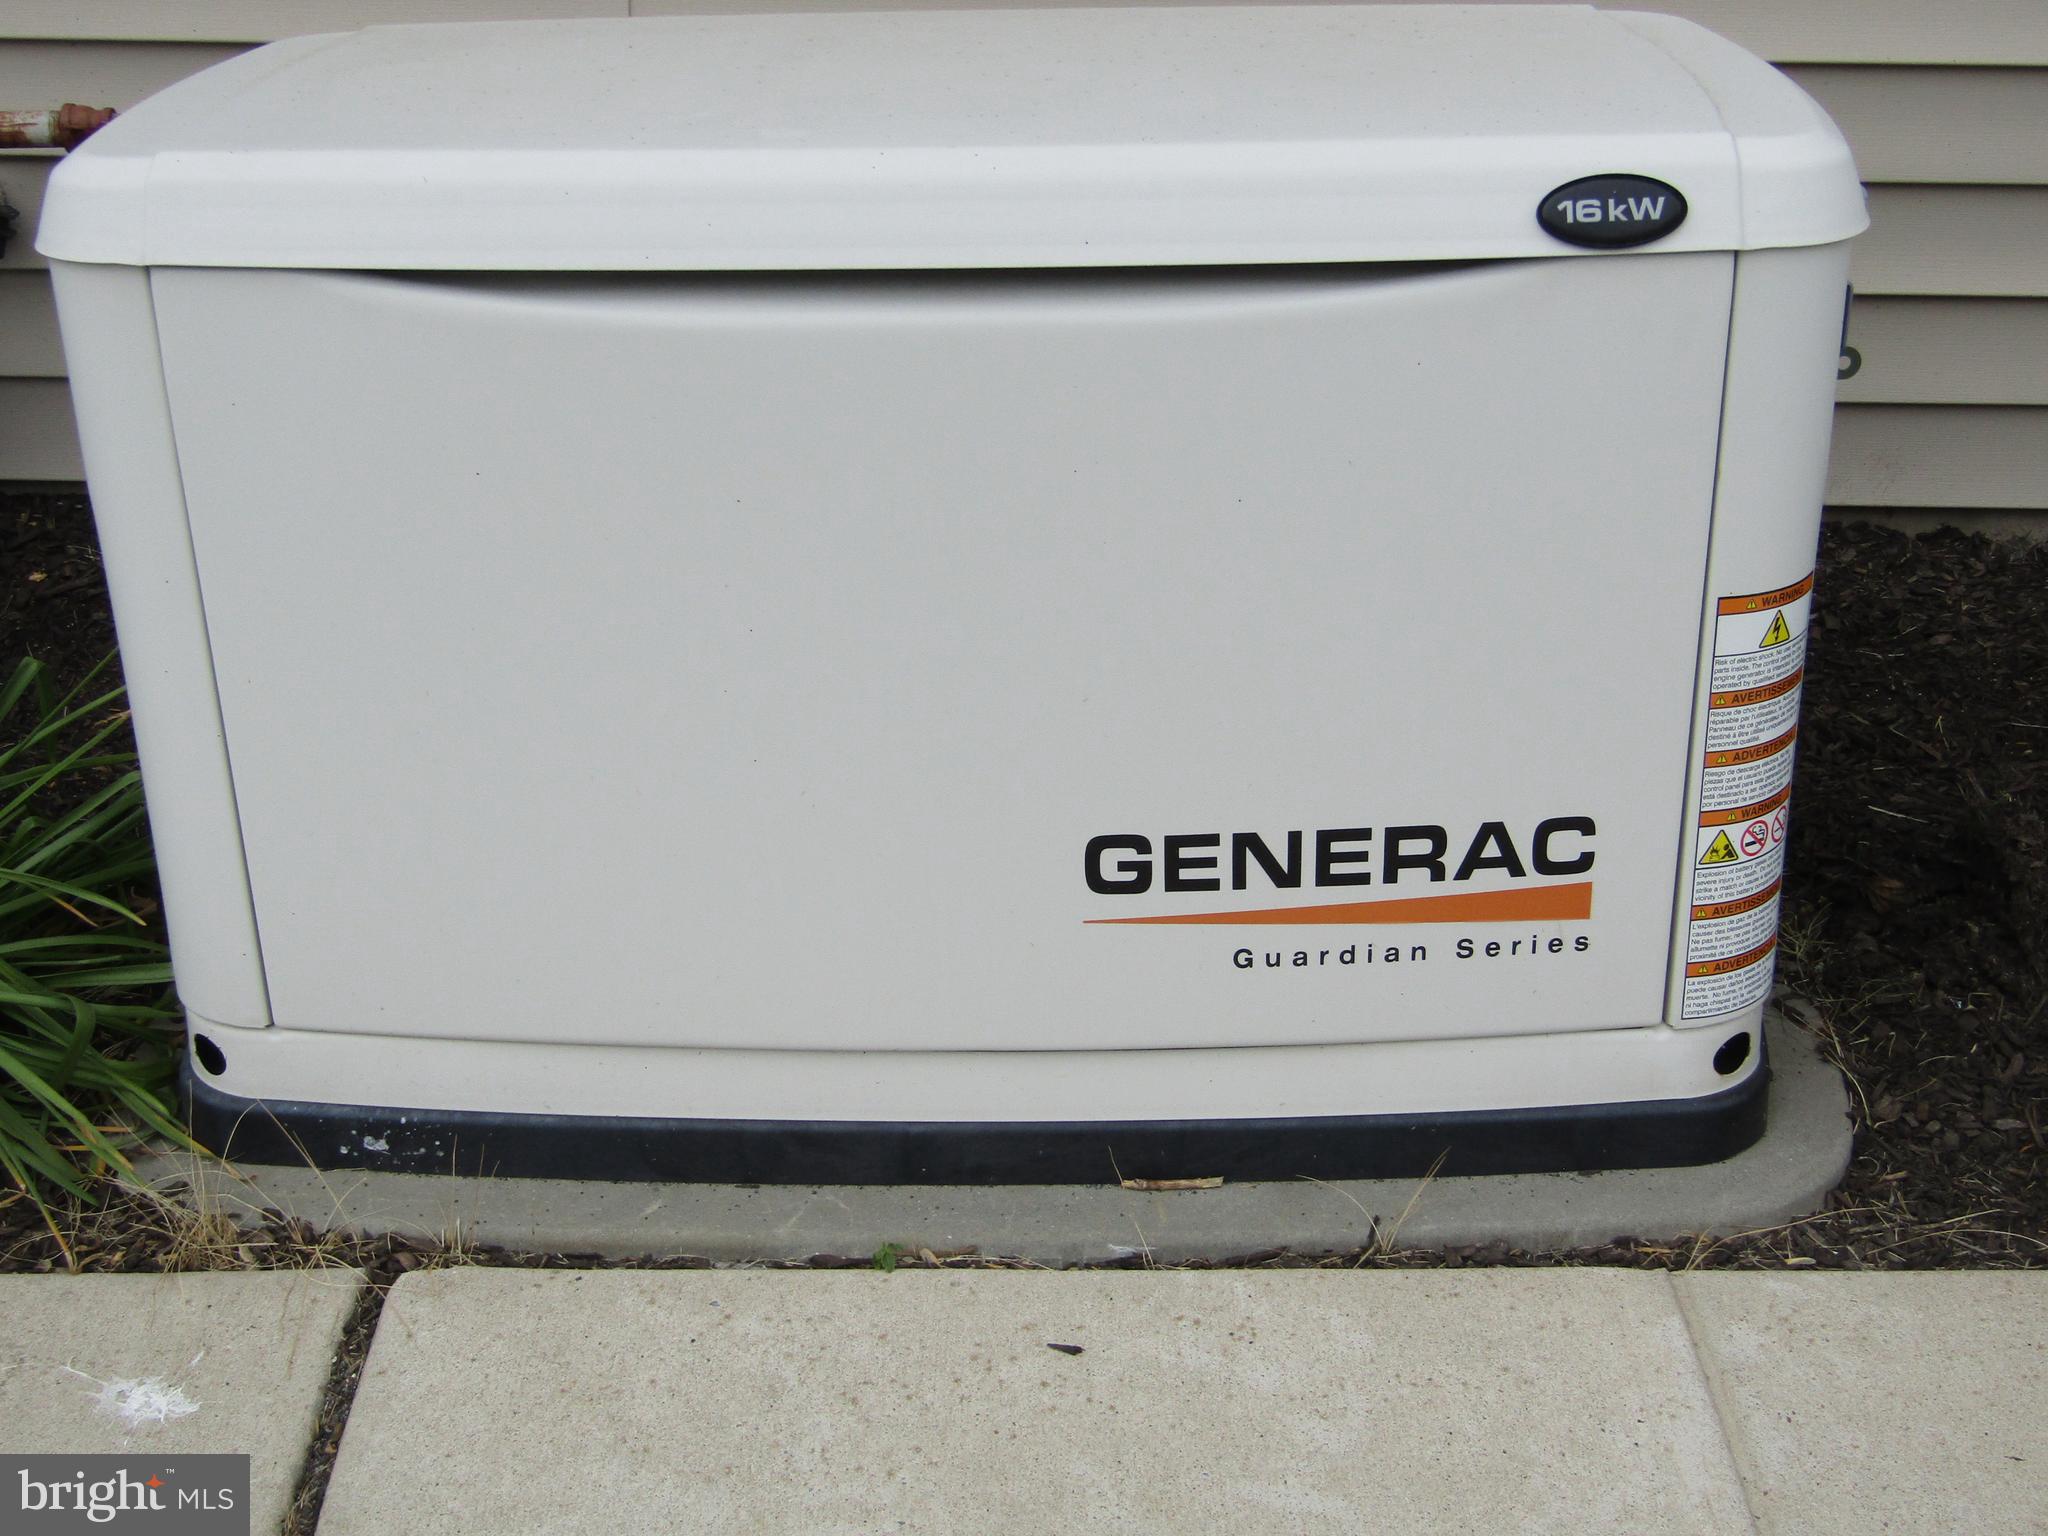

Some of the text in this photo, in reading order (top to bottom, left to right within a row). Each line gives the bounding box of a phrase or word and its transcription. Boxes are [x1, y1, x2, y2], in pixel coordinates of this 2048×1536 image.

[1557, 196, 1665, 223] 16 kW
[1762, 584, 1804, 607] WARNING
[1715, 659, 1727, 667] Risk
[1737, 656, 1757, 664] electric
[1714, 667, 1729, 675] parts
[1714, 674, 1735, 682] engine
[1737, 669, 1765, 680] generator
[1713, 681, 1741, 690] operated
[1711, 710, 1732, 718] Risque
[1709, 725, 1736, 733] Panneau
[1707, 741, 1739, 749] personnel
[1724, 776, 1736, 784] que
[1703, 785, 1724, 793] control
[1724, 783, 1740, 791] panel
[1716, 790, 1744, 799] destinado
[1713, 798, 1739, 808] personal
[1085, 816, 1596, 894] GENERAC
[1697, 871, 1727, 879] Explosion
[1696, 878, 1717, 886] severe
[1695, 886, 1712, 894] strike
[1233, 934, 1589, 969] Guardian Series
[1686, 987, 1706, 995] puede
[1692, 1001, 1709, 1009] haga
